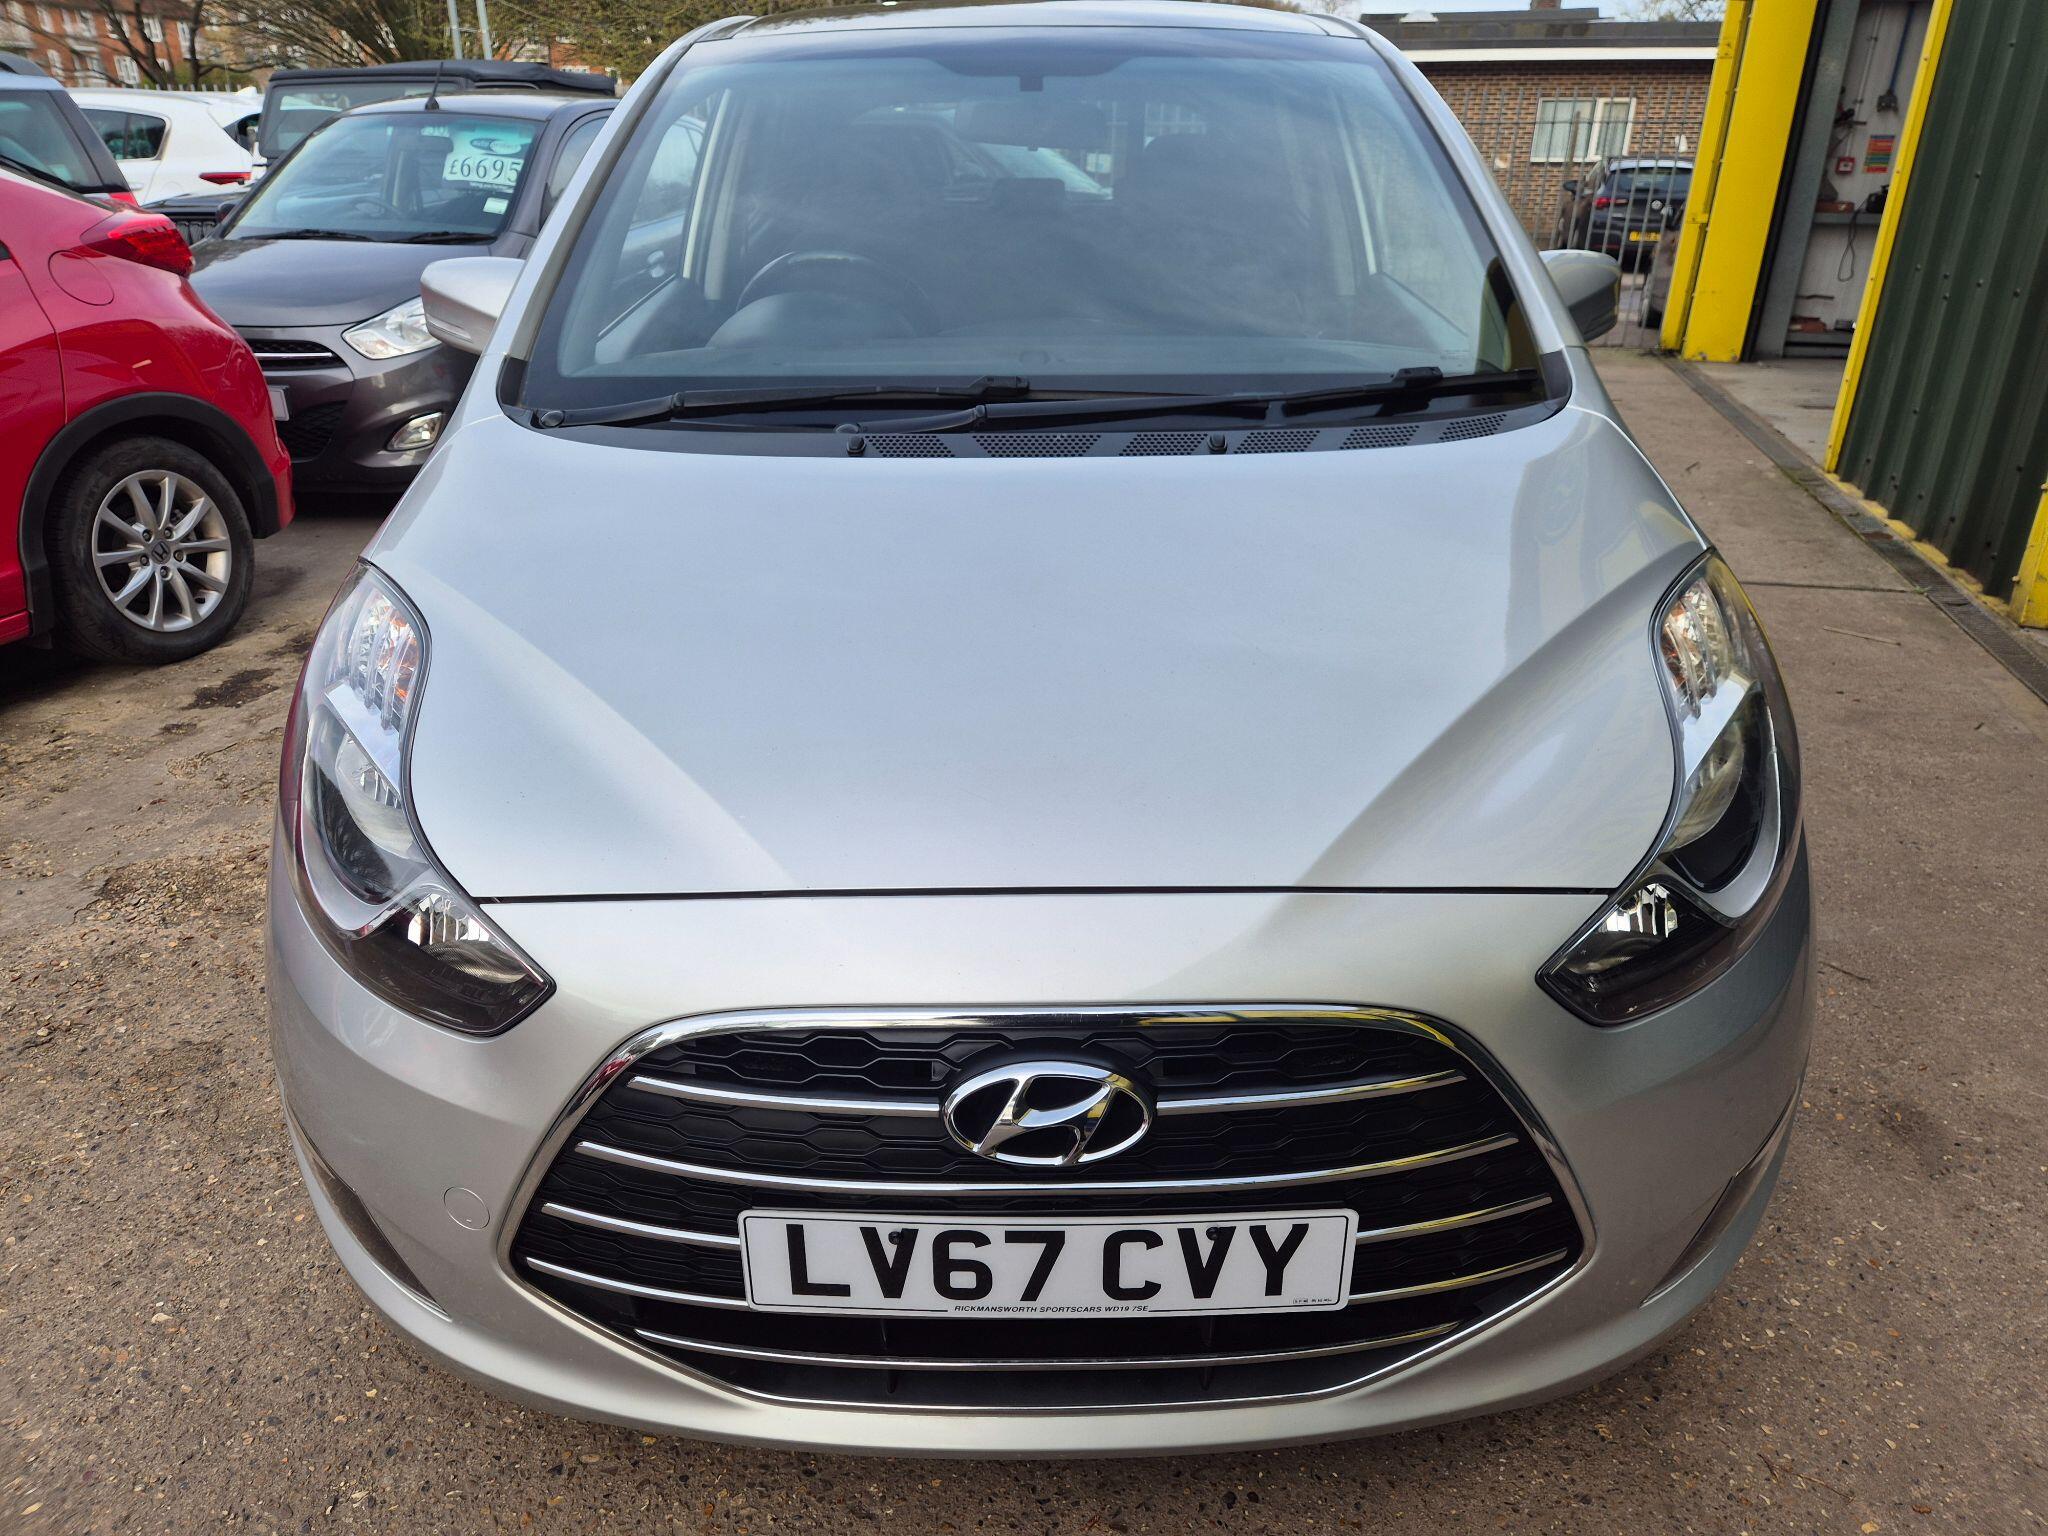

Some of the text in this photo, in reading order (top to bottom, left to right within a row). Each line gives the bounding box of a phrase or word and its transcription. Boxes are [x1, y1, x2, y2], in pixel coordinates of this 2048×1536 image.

[449, 156, 521, 183] £6695
[786, 1223, 1310, 1302] LV67 CVY
[954, 1305, 1037, 1313] RICKMANSWORTH
[1039, 1305, 1102, 1313] SPORTSCARS
